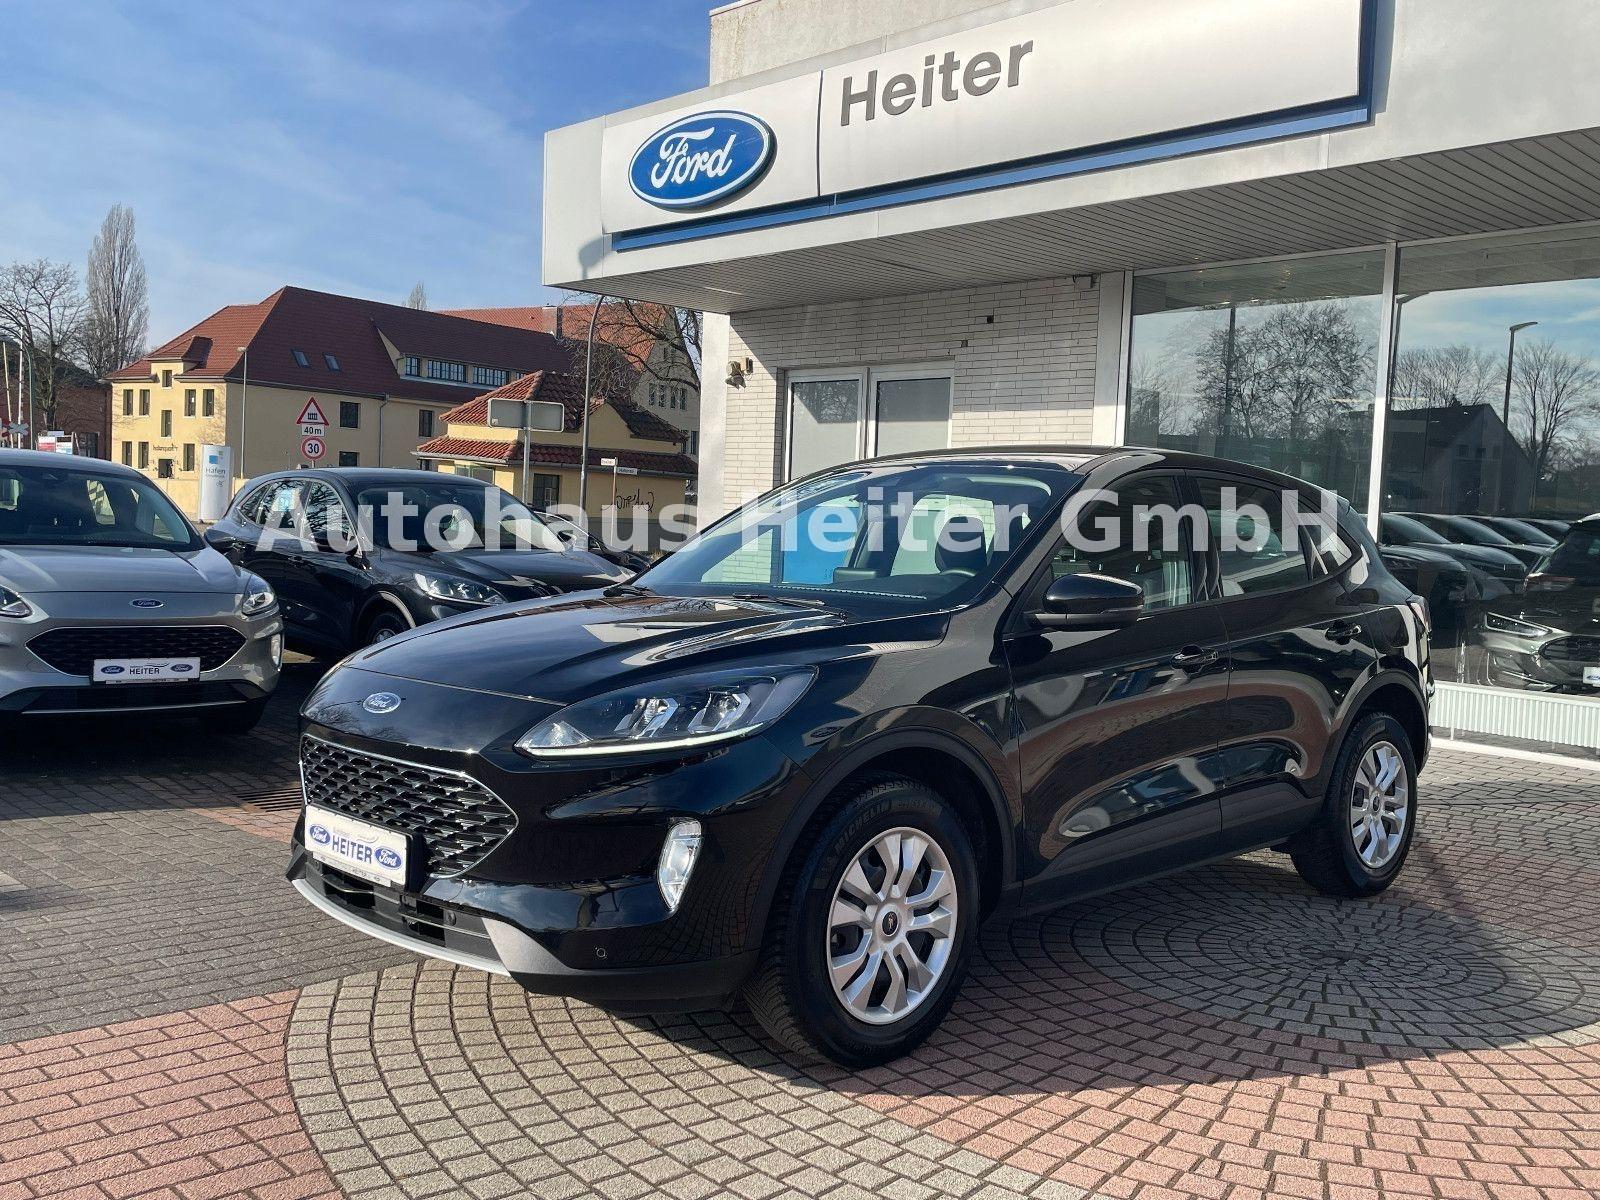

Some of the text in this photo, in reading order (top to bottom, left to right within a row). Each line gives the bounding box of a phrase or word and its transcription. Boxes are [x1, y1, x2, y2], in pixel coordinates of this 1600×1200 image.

[840, 40, 1034, 127] Heiter
[650, 126, 736, 188] Ford
[307, 443, 320, 454] 30
[129, 667, 160, 675] HEITER
[834, 801, 890, 853] MICHELIN
[332, 834, 373, 865] HEITER
